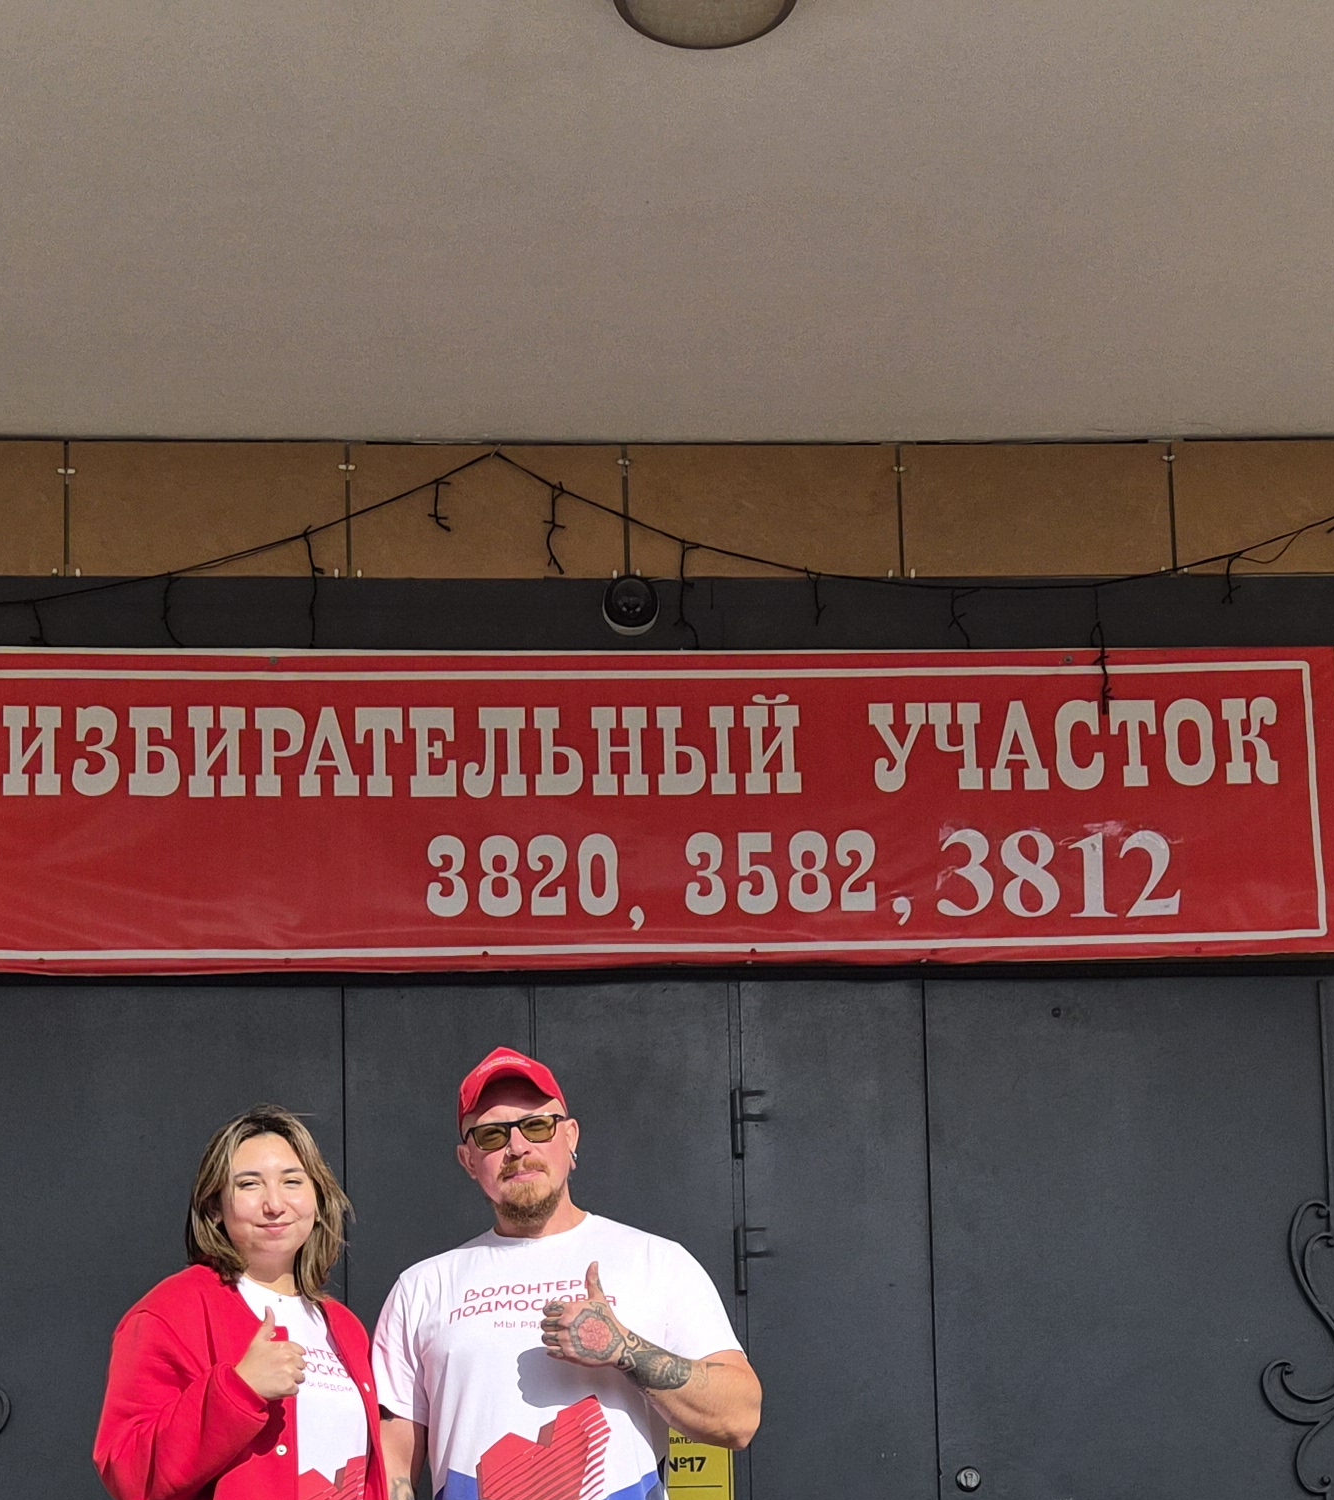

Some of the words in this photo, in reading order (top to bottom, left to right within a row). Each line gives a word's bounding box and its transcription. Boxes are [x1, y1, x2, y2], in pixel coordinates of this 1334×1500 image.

[2, 693, 802, 798] ИЗБИРАТЕЛЬНЫЙ
[867, 696, 1279, 793] УЧАСТОК
[426, 832, 645, 931] 3820,
[684, 829, 912, 926] 3582,
[936, 828, 1181, 918] 3812
[493, 1321, 515, 1329] МЫ
